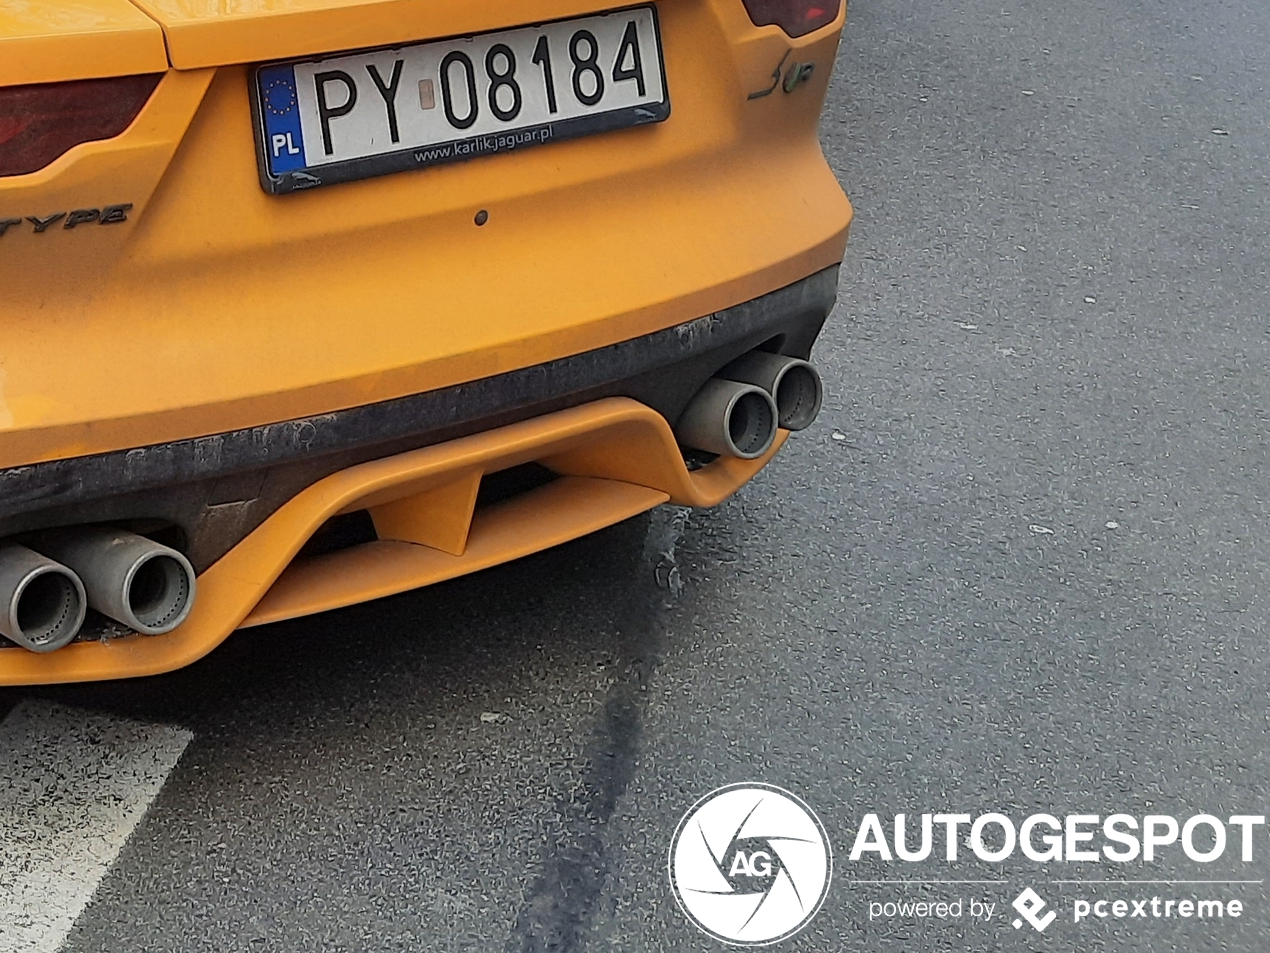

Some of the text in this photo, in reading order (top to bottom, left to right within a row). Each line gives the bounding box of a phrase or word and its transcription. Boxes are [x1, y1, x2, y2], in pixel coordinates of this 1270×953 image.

[313, 20, 647, 155] PY 08184
[272, 131, 300, 158] PL
